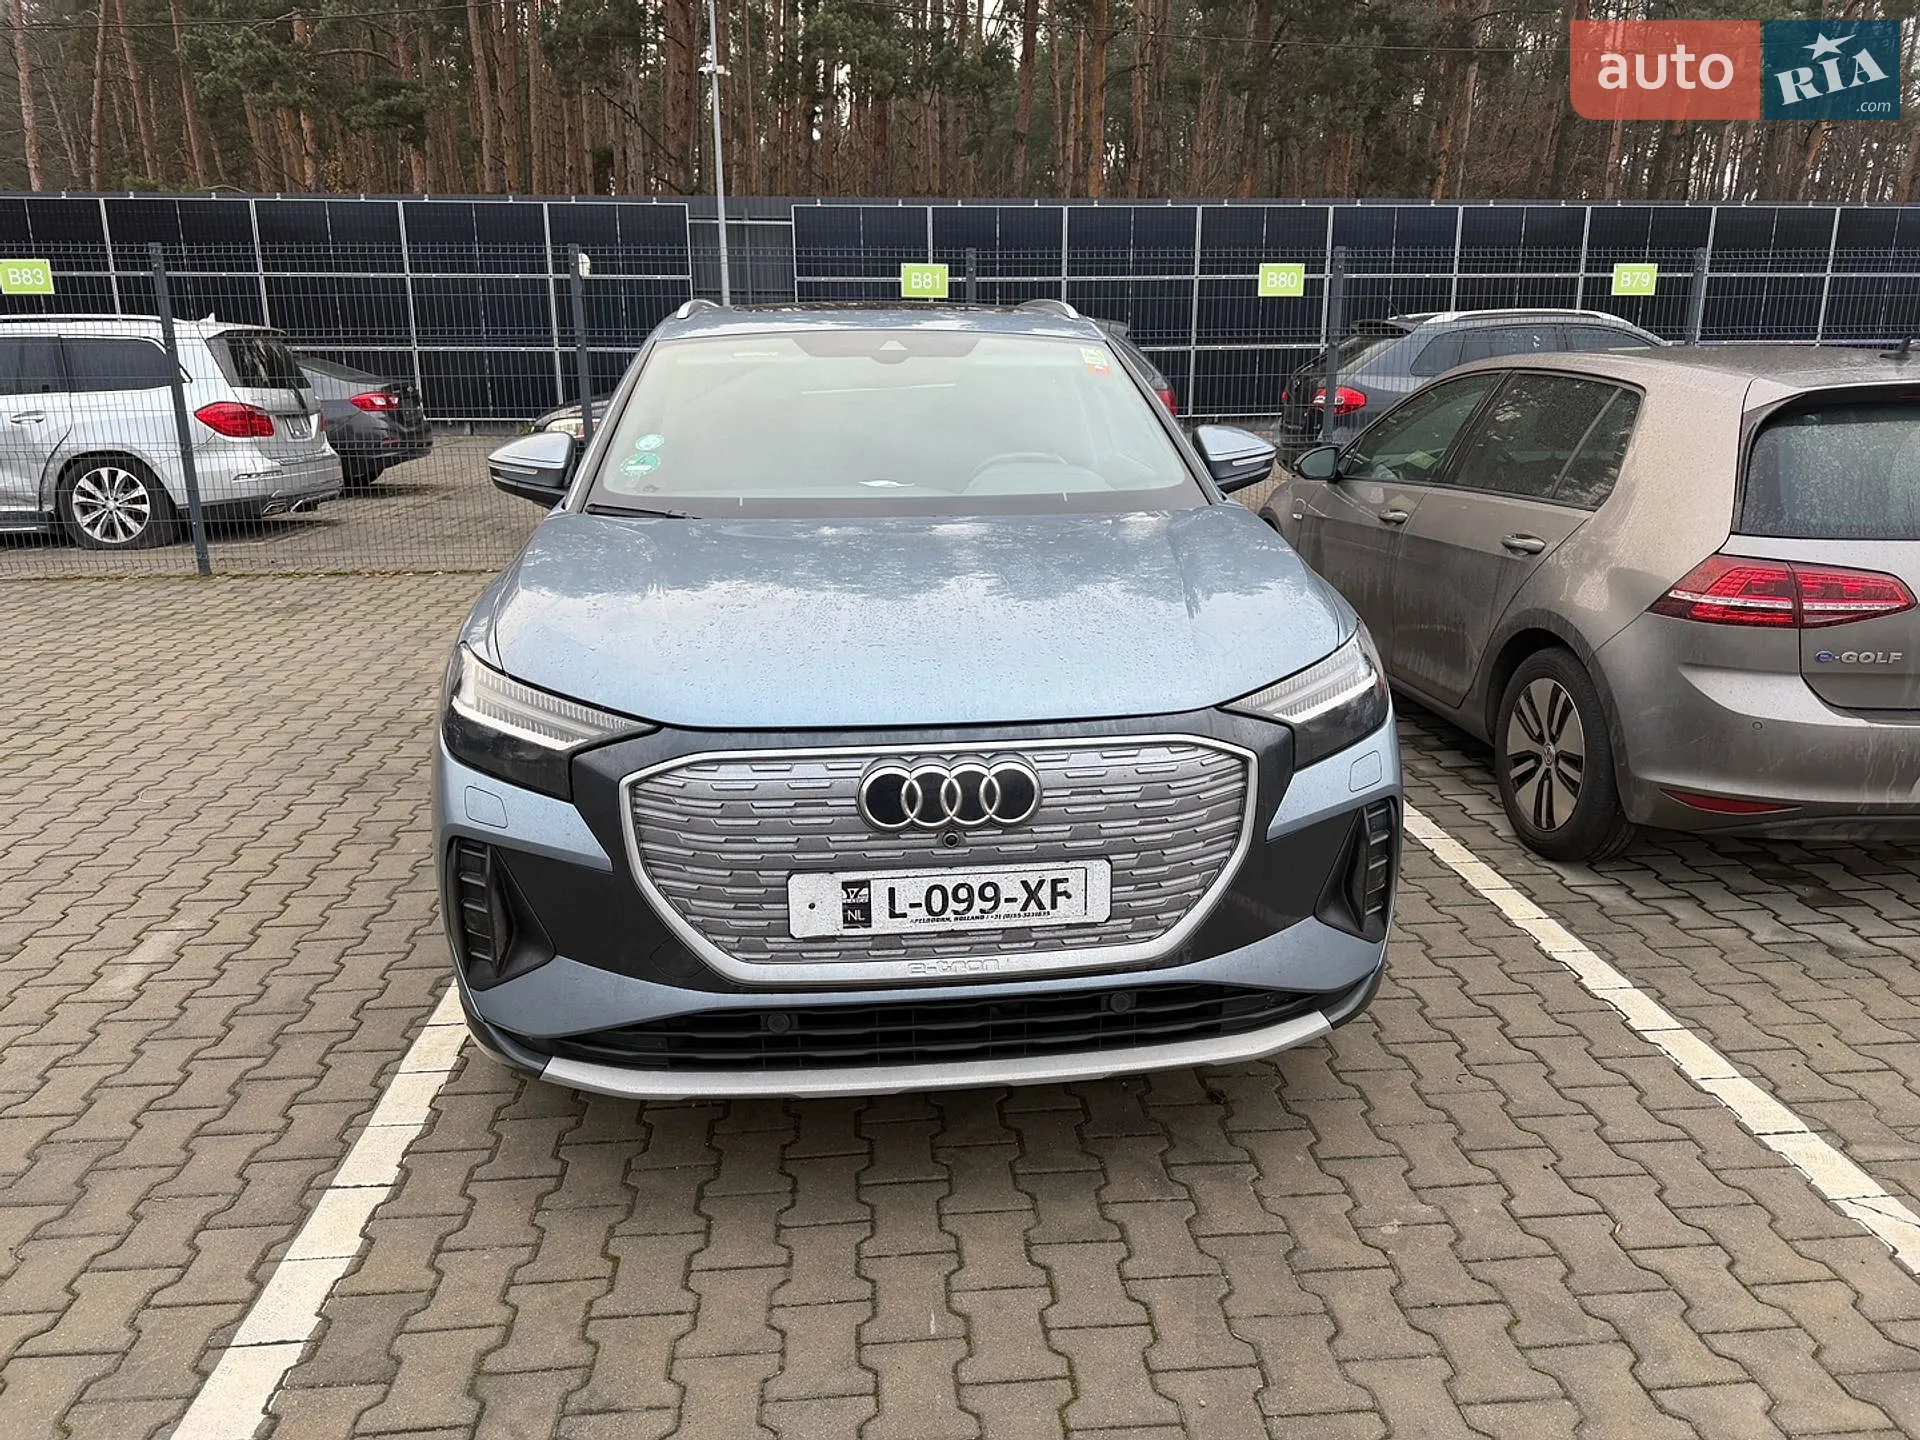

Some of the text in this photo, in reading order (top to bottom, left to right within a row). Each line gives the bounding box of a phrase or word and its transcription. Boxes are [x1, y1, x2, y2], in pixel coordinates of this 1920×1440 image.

[8, 268, 44, 285] B83
[911, 272, 940, 289] B81
[1266, 272, 1298, 288] B80
[1621, 271, 1650, 288] B79
[888, 877, 1071, 919] L-099-XF
[847, 909, 866, 921] NL
